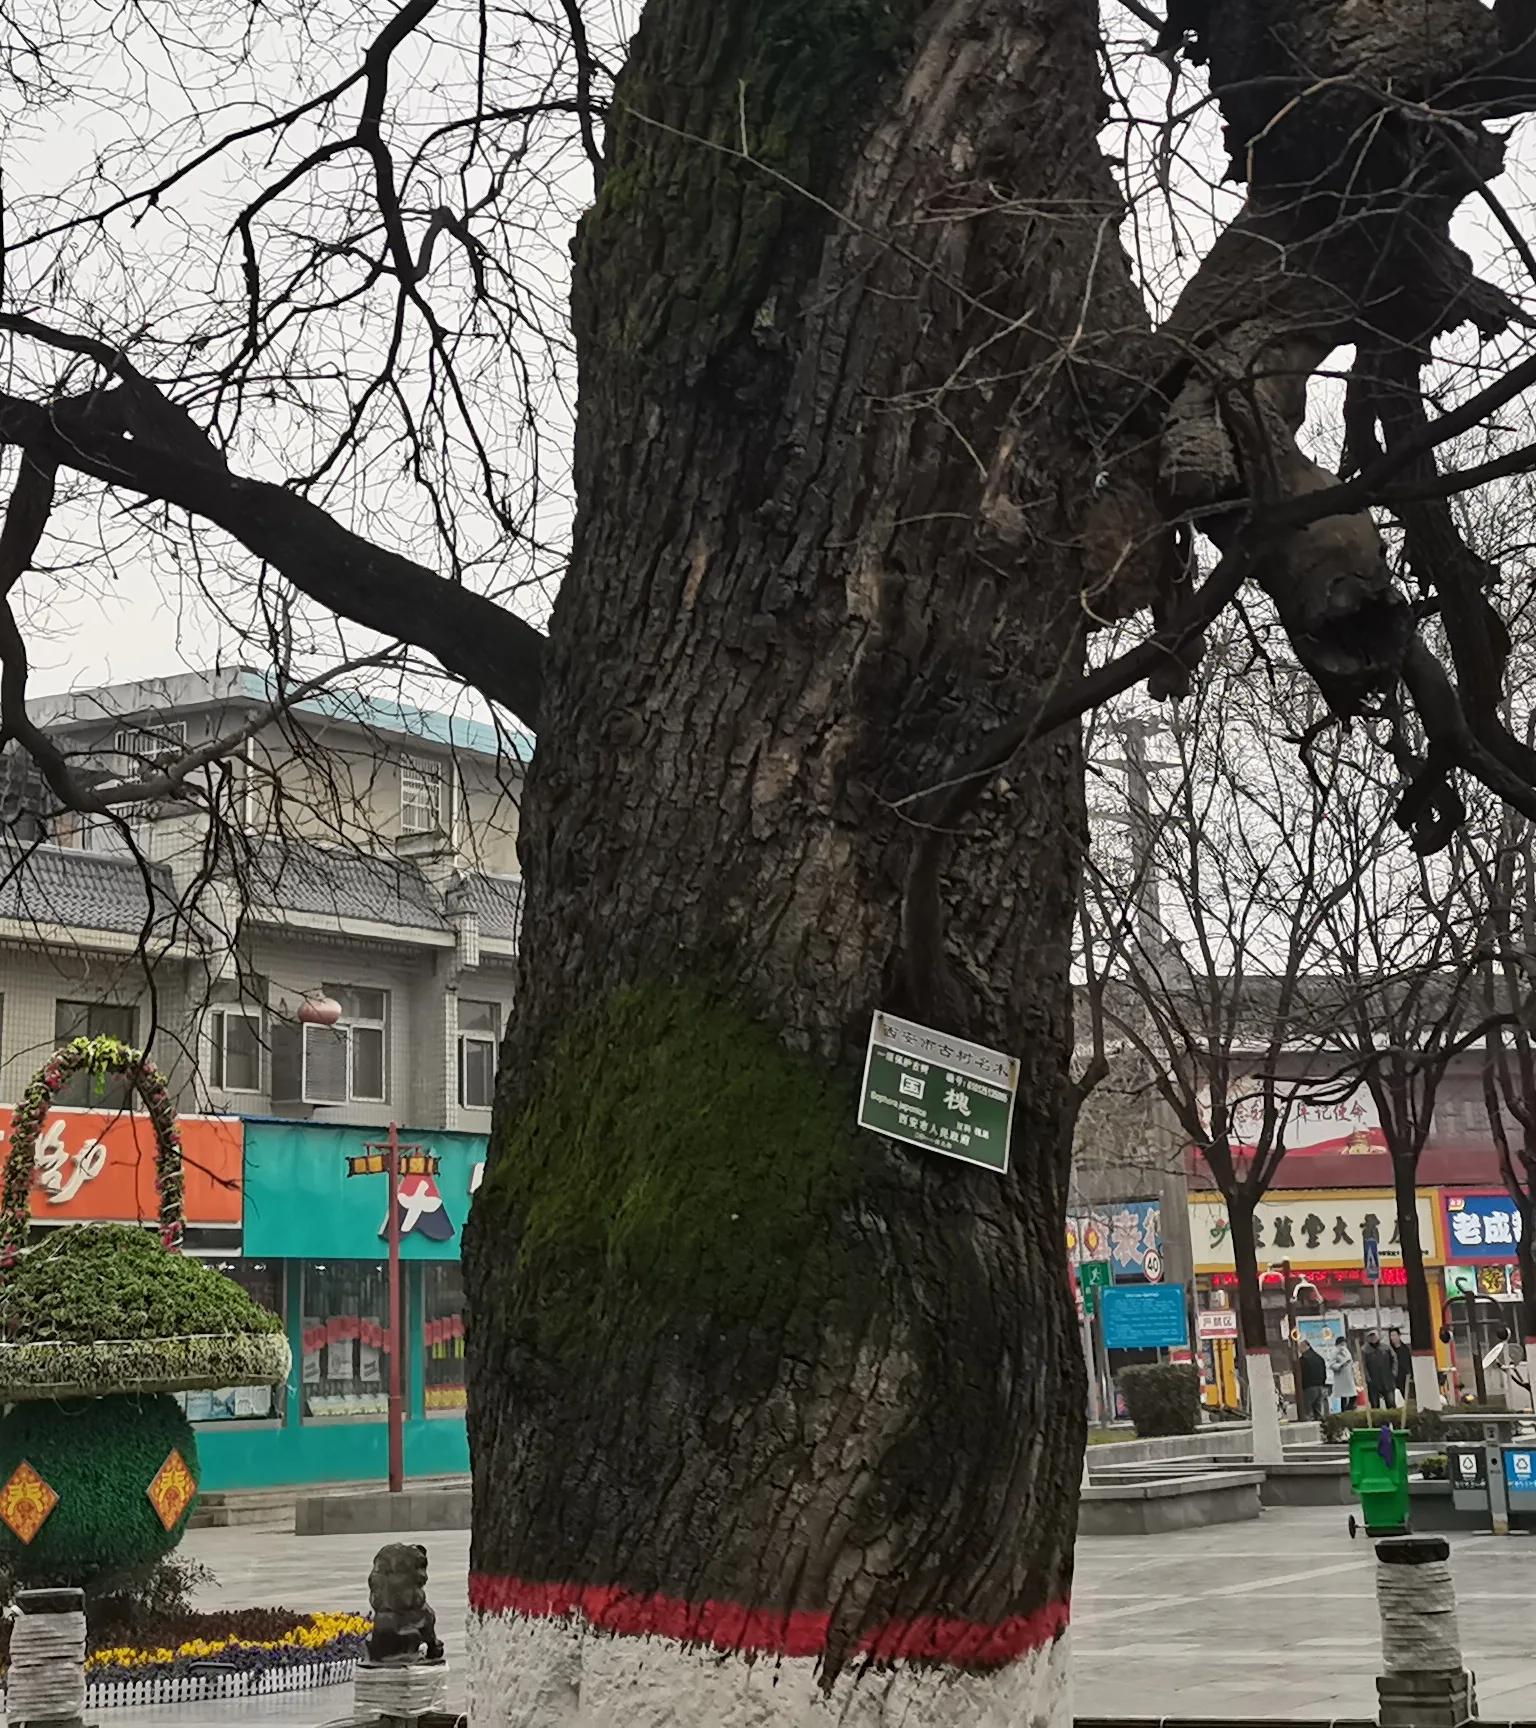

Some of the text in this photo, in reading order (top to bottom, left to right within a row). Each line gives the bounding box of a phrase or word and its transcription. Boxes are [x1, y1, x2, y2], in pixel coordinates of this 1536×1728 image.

[882, 1024, 1009, 1077] 西安市古树名木
[899, 1073, 972, 1116] 国槐
[1147, 1258, 1159, 1271] 40
